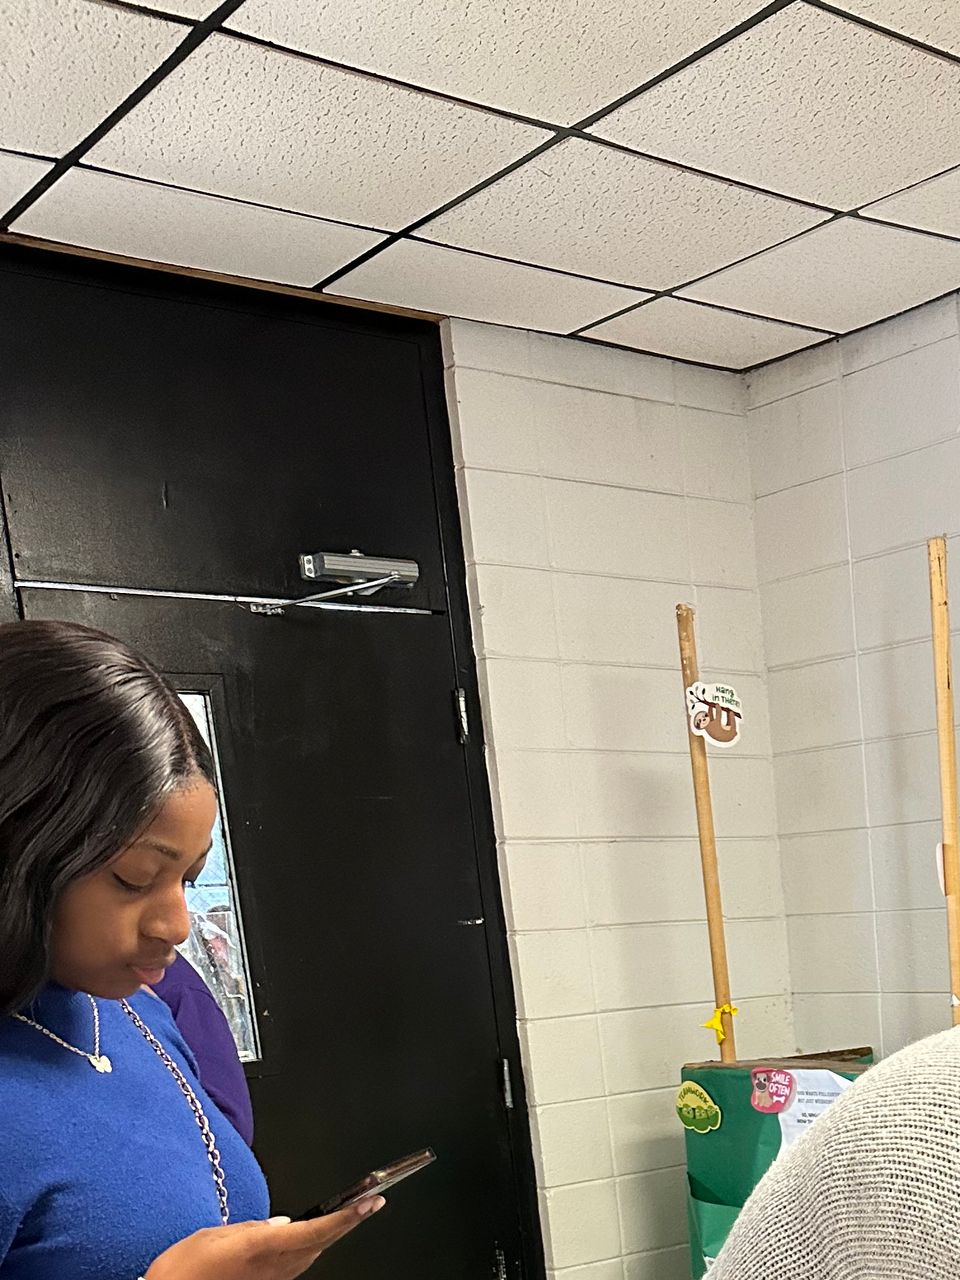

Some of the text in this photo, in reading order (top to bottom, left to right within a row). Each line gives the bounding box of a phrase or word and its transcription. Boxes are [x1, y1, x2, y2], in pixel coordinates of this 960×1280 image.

[770, 1072, 791, 1084] SMILE
[679, 1087, 709, 1105] TEAMWORK
[768, 1083, 790, 1096] OFTEN
